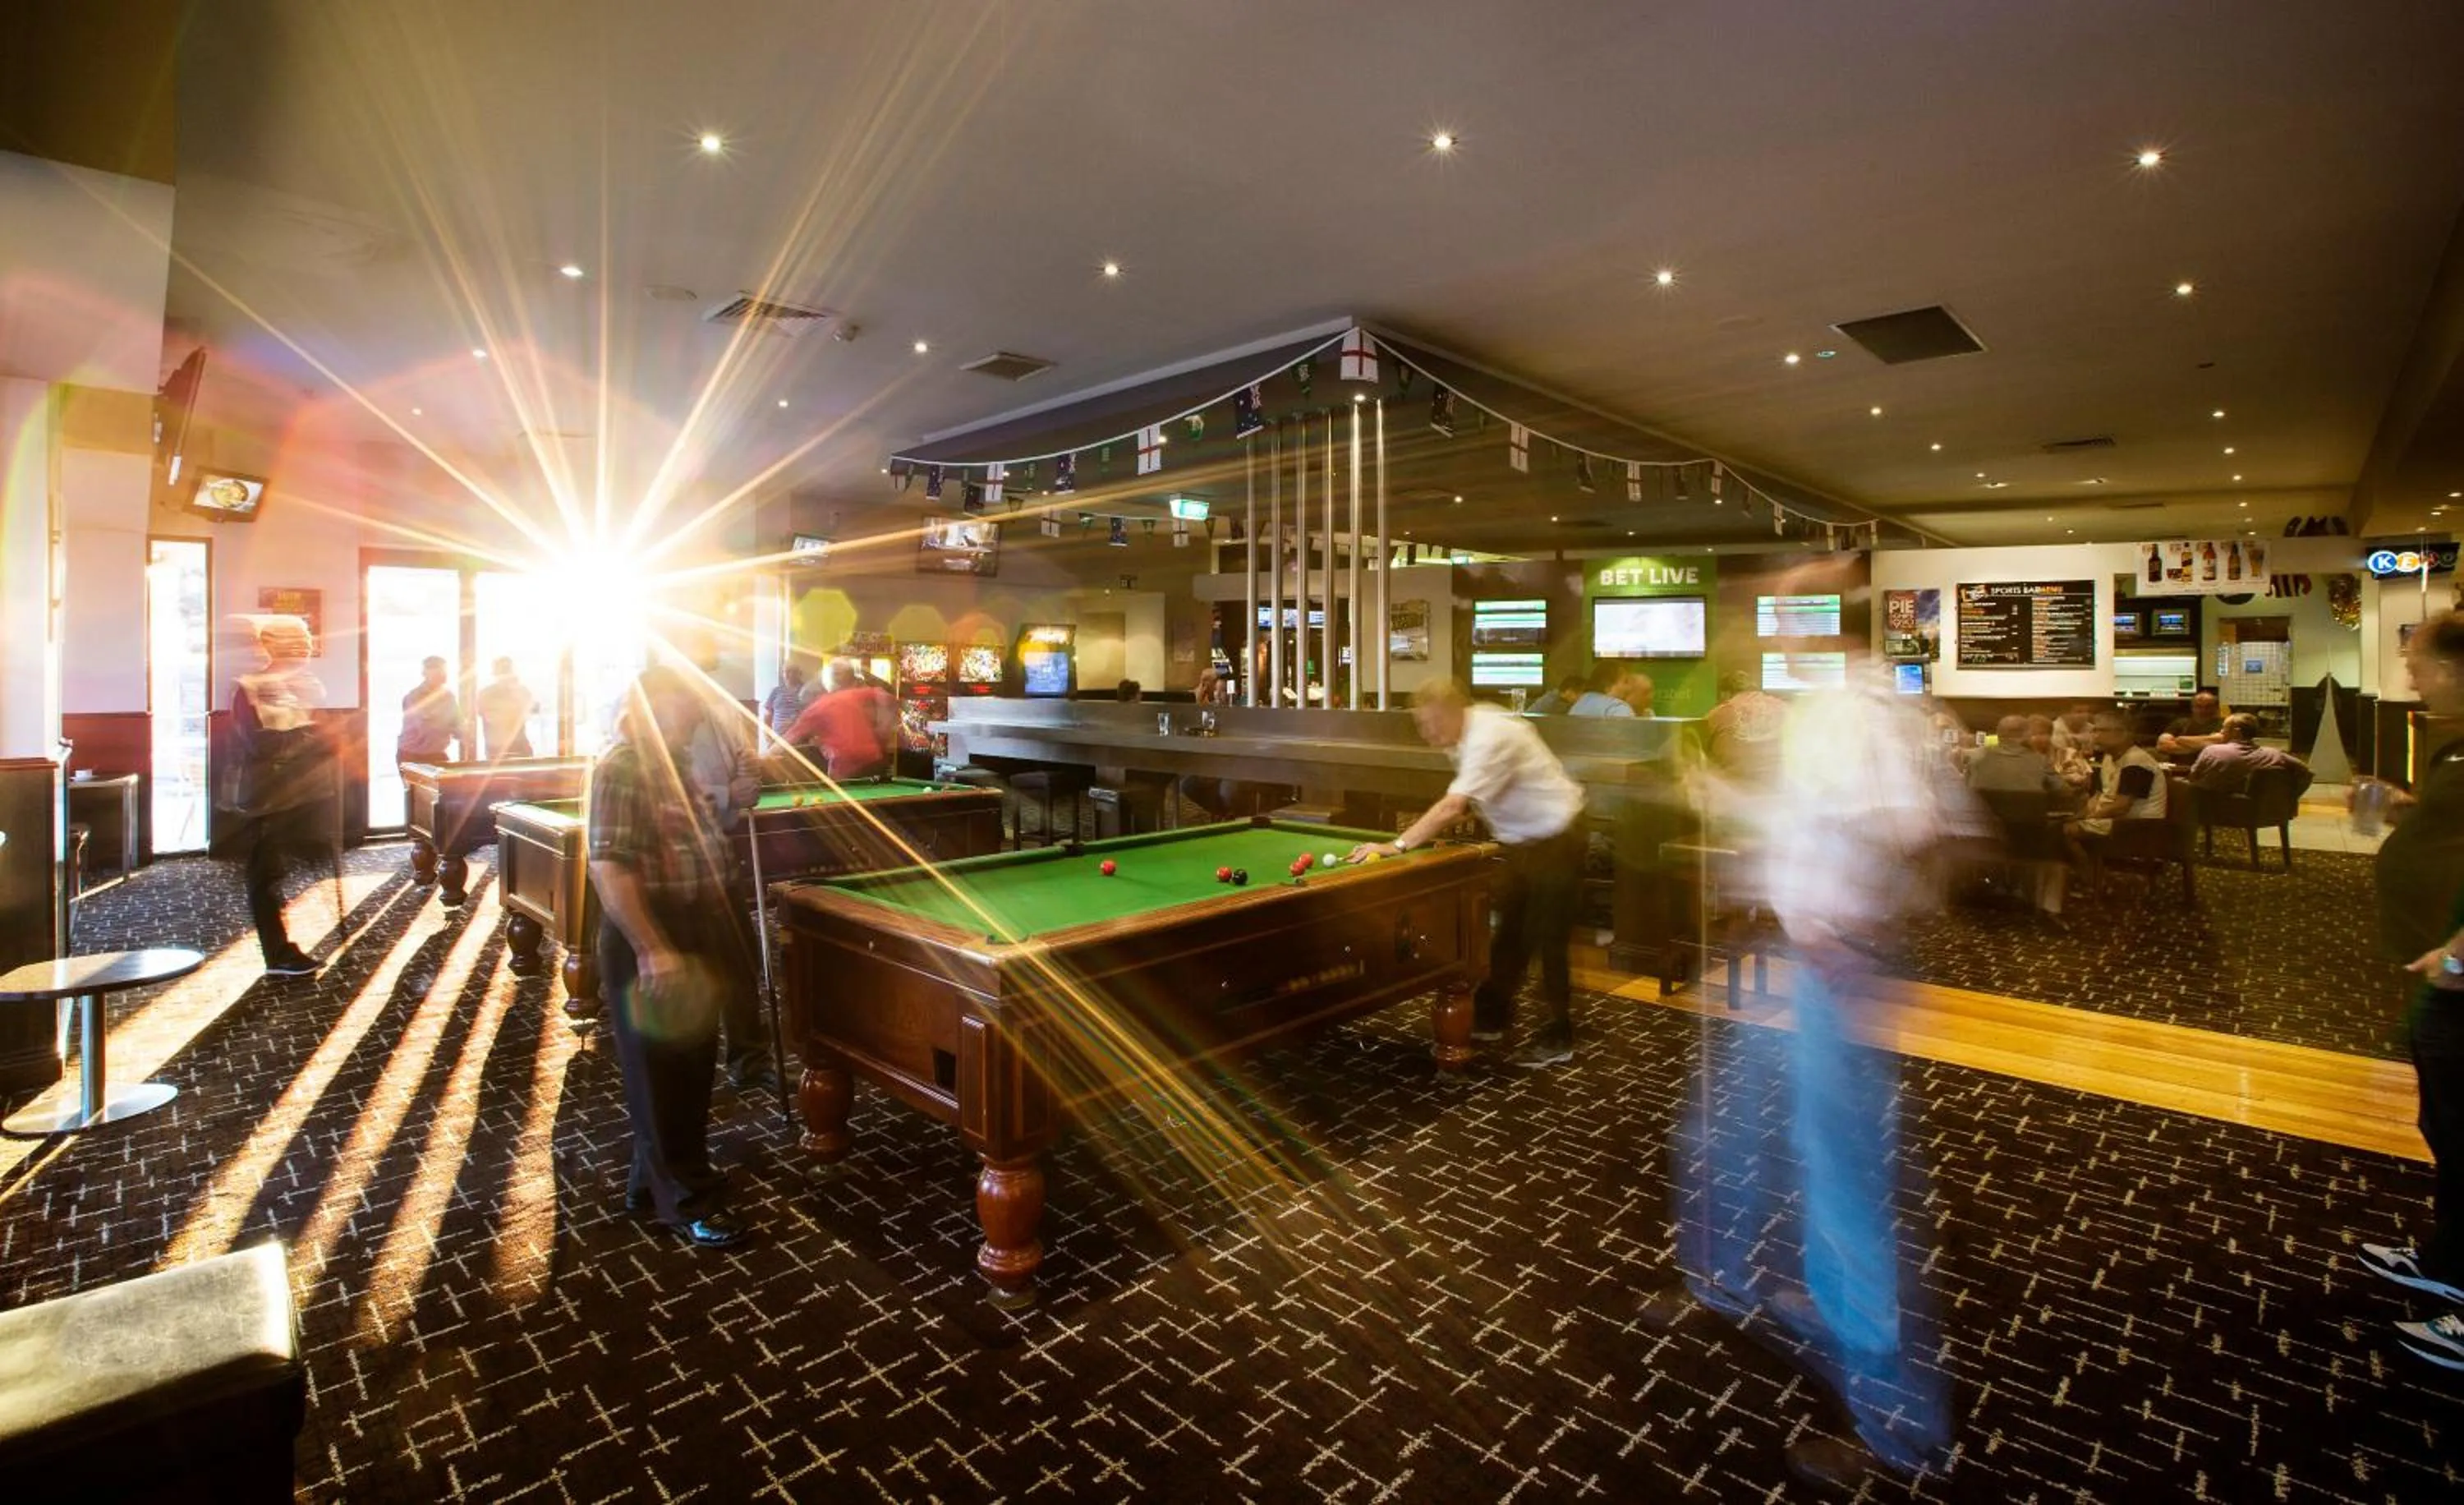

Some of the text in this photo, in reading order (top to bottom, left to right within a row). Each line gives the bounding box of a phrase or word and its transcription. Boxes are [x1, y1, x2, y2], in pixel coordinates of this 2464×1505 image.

[1601, 566, 1699, 585] BET LIVE
[1889, 601, 1915, 613] PIE
